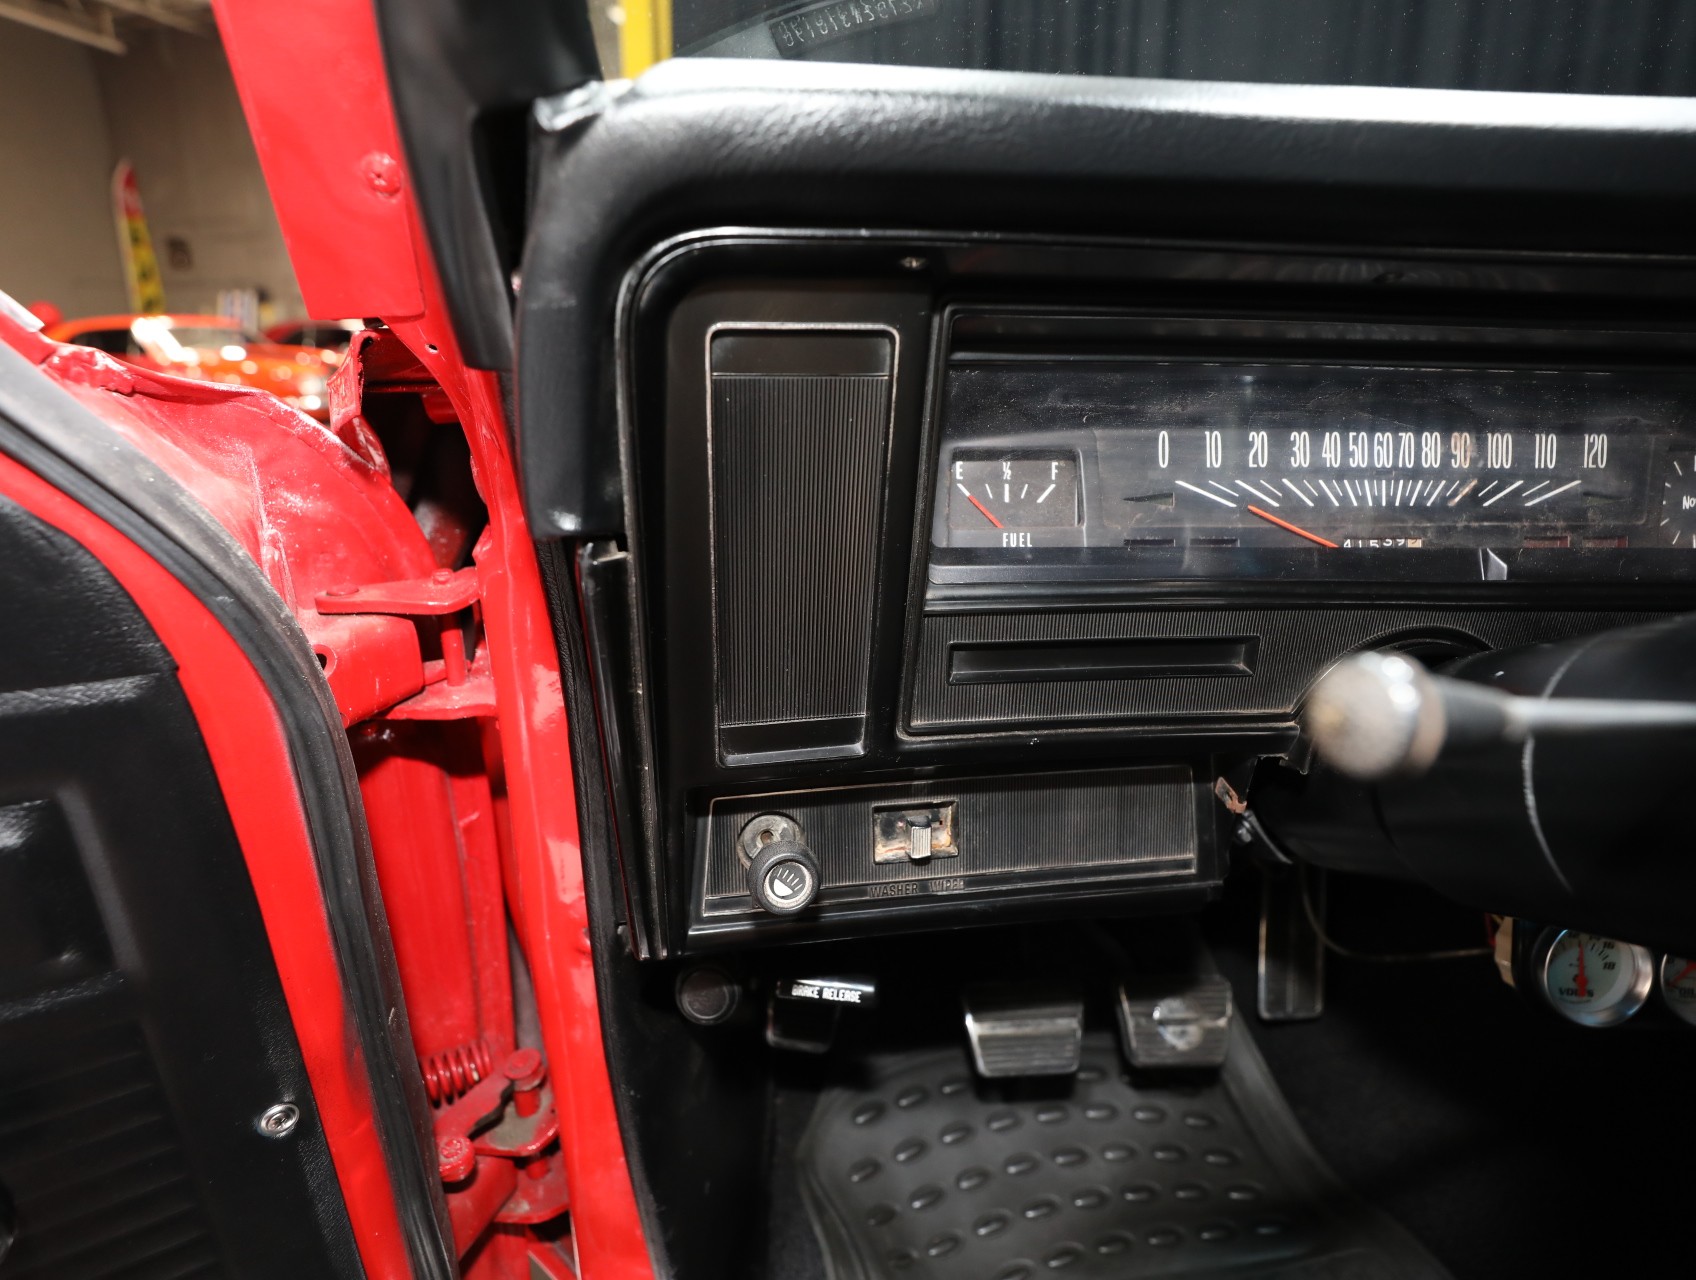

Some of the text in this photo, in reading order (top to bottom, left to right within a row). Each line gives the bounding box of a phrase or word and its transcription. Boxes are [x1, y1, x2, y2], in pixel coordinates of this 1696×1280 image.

[1158, 430, 1608, 469] 0 10 20 30 40 50 60 70 80 90 100 110 120
[955, 461, 963, 480] E
[1051, 462, 1059, 480] F
[1002, 532, 1033, 548] FUEL
[869, 882, 919, 898] WASHER
[791, 984, 862, 1003] BRAKE RELEASE
[1558, 987, 1594, 998] VOLS
